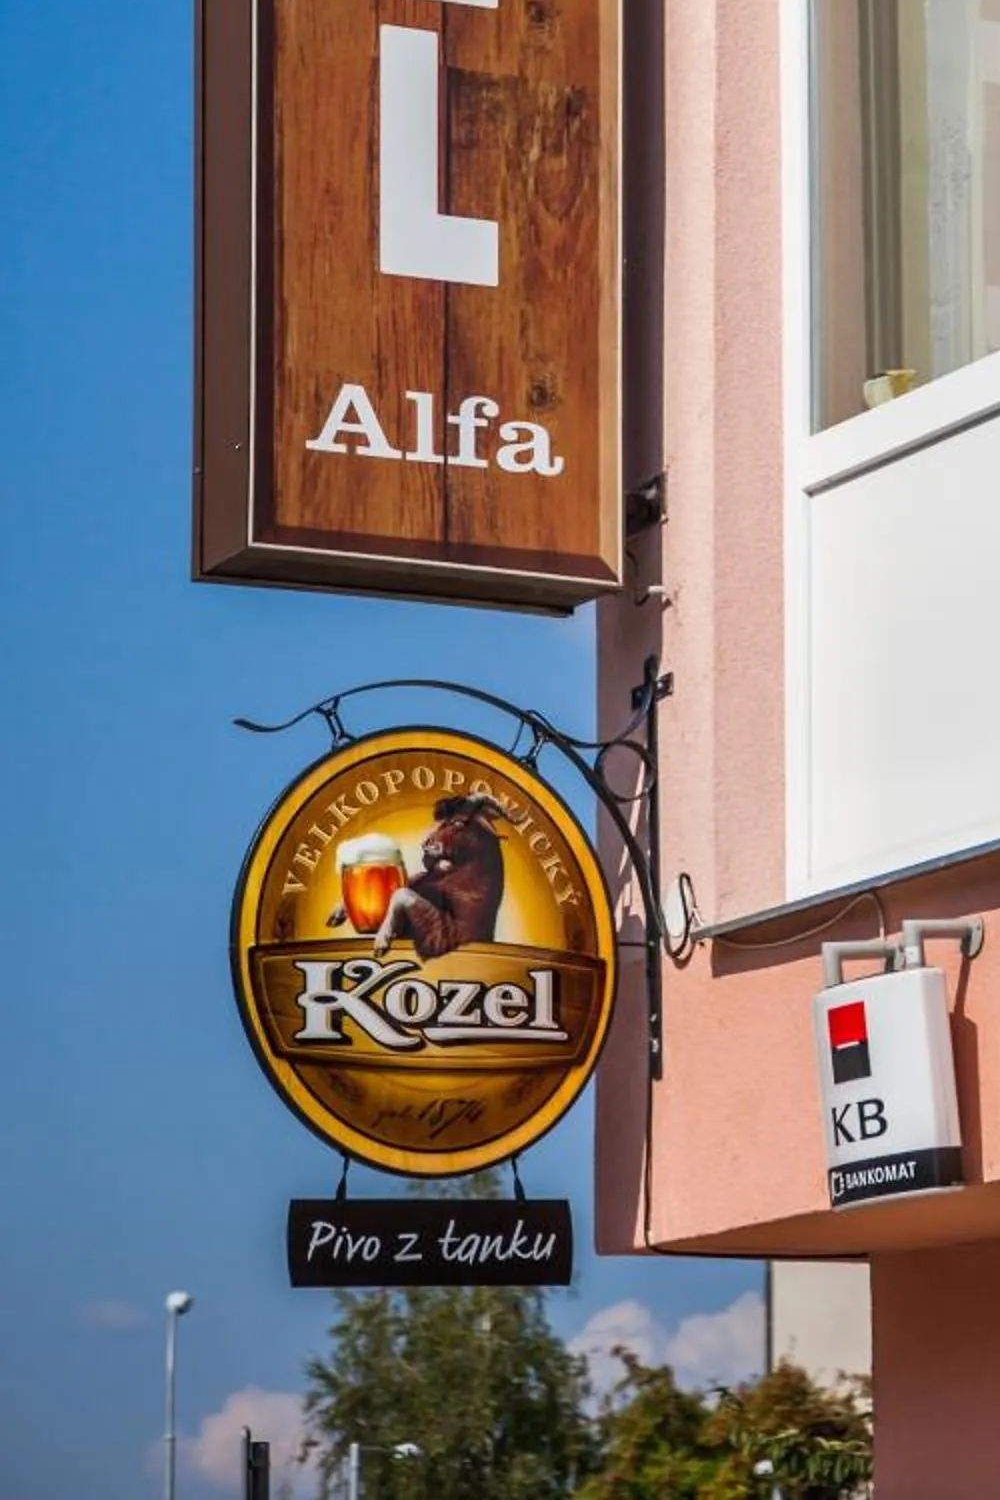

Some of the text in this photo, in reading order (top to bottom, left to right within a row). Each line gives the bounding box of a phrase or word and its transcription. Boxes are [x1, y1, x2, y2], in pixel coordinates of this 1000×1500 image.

[305, 383, 565, 477] Alfa
[294, 960, 568, 1048] Kozel
[831, 1098, 889, 1147] KB
[845, 1161, 918, 1190] BANKOMAT
[307, 1219, 557, 1266] Pivo z tanku
